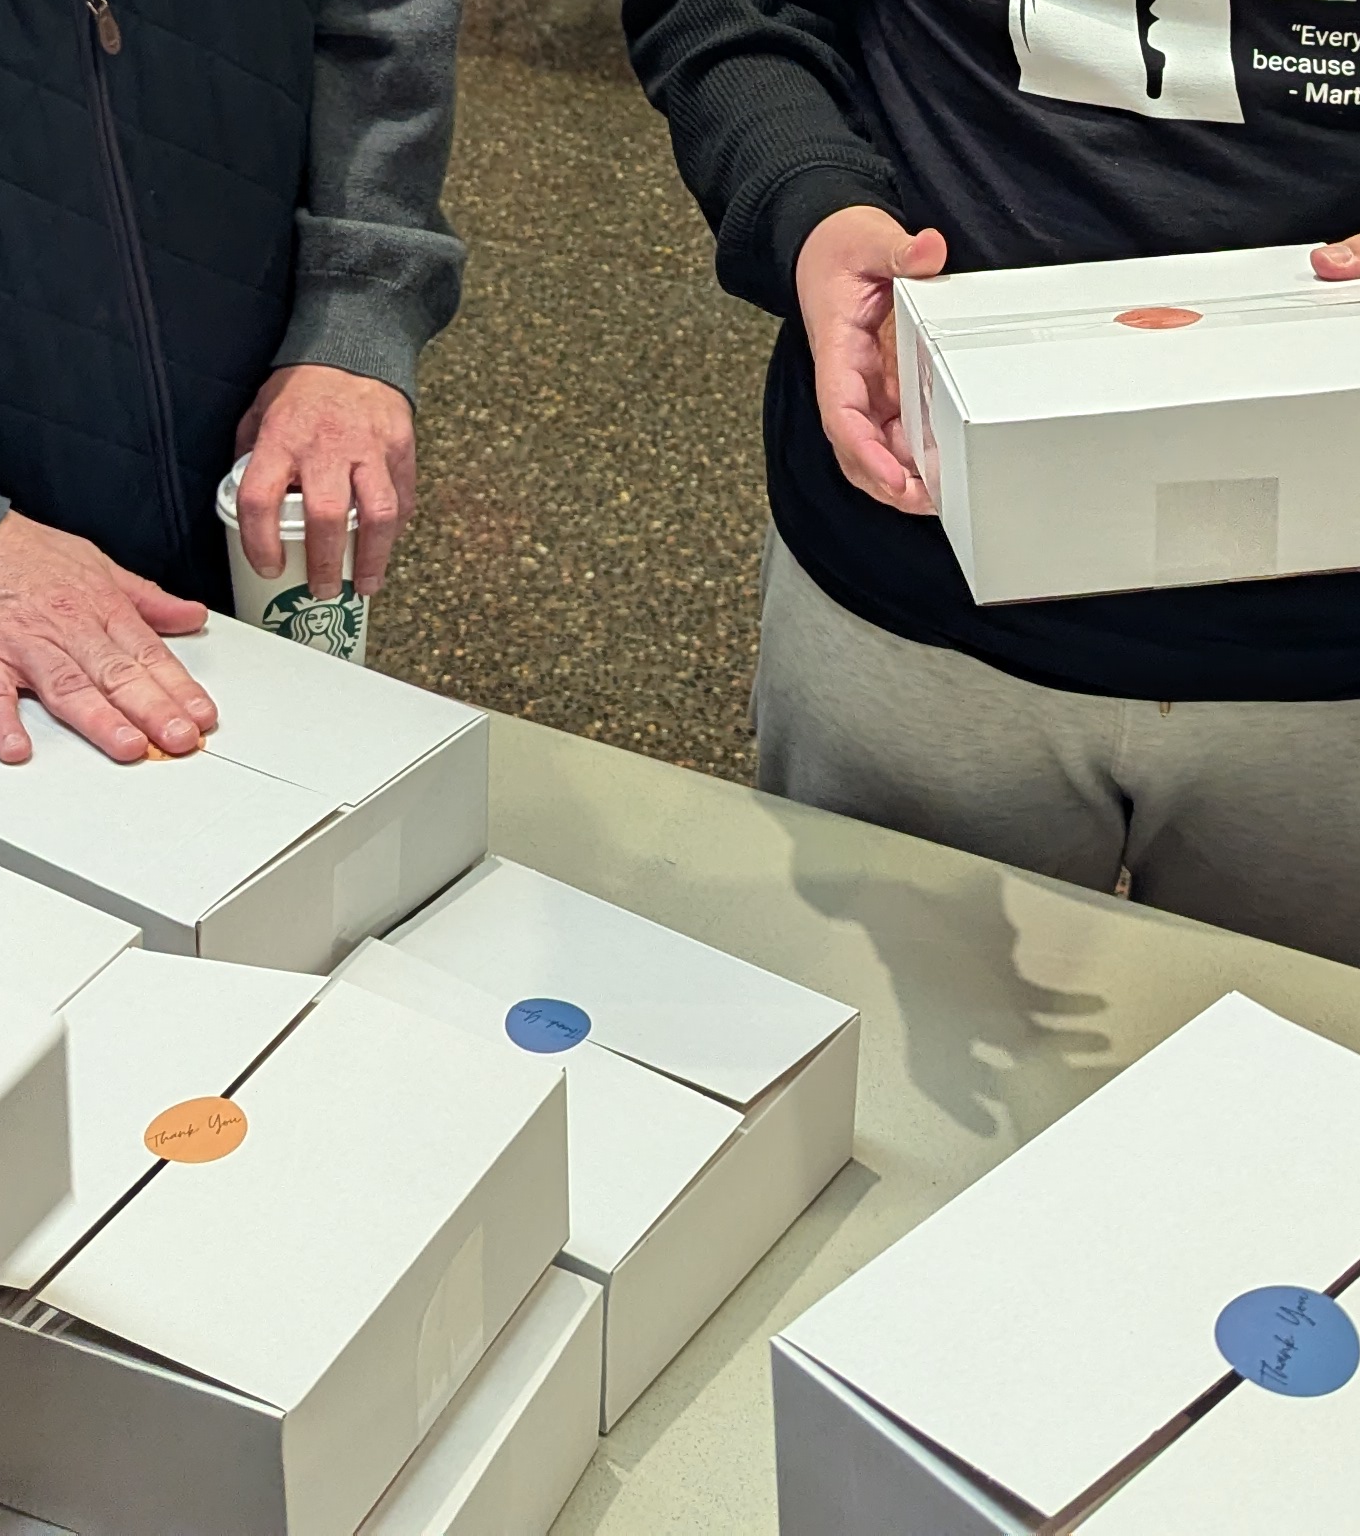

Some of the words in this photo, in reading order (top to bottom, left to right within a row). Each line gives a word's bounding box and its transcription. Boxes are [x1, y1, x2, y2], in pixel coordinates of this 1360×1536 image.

[1252, 48, 1357, 76] because
[146, 1123, 200, 1148] Thank
[208, 1113, 243, 1135] You
[1275, 1292, 1317, 1327] You
[1259, 1334, 1299, 1386] Thank
